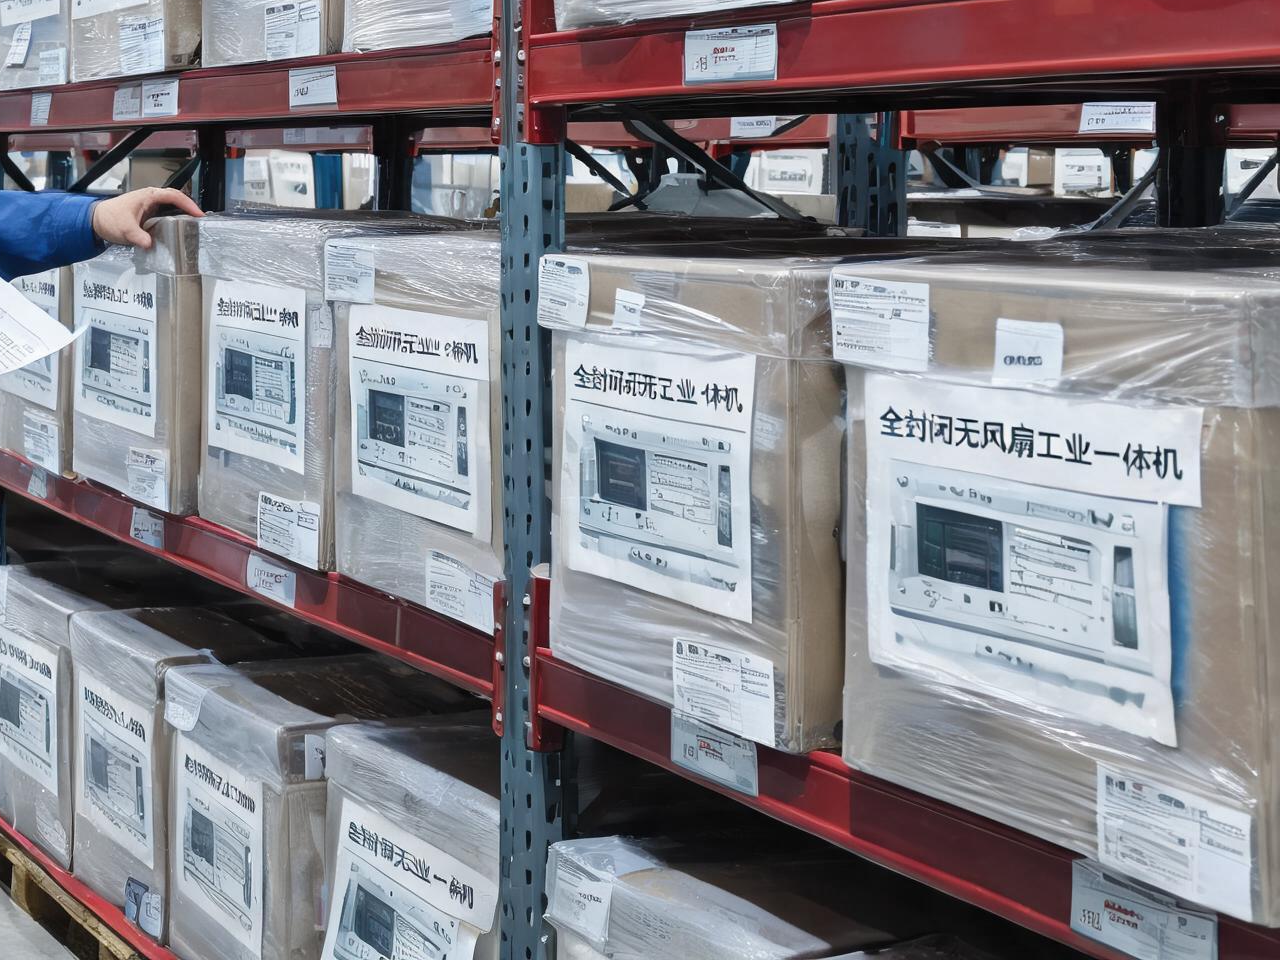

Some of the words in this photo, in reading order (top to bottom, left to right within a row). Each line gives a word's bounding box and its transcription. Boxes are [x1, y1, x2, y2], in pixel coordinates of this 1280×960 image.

[879, 404, 1184, 481] 全封闭无风扇工业一体机
